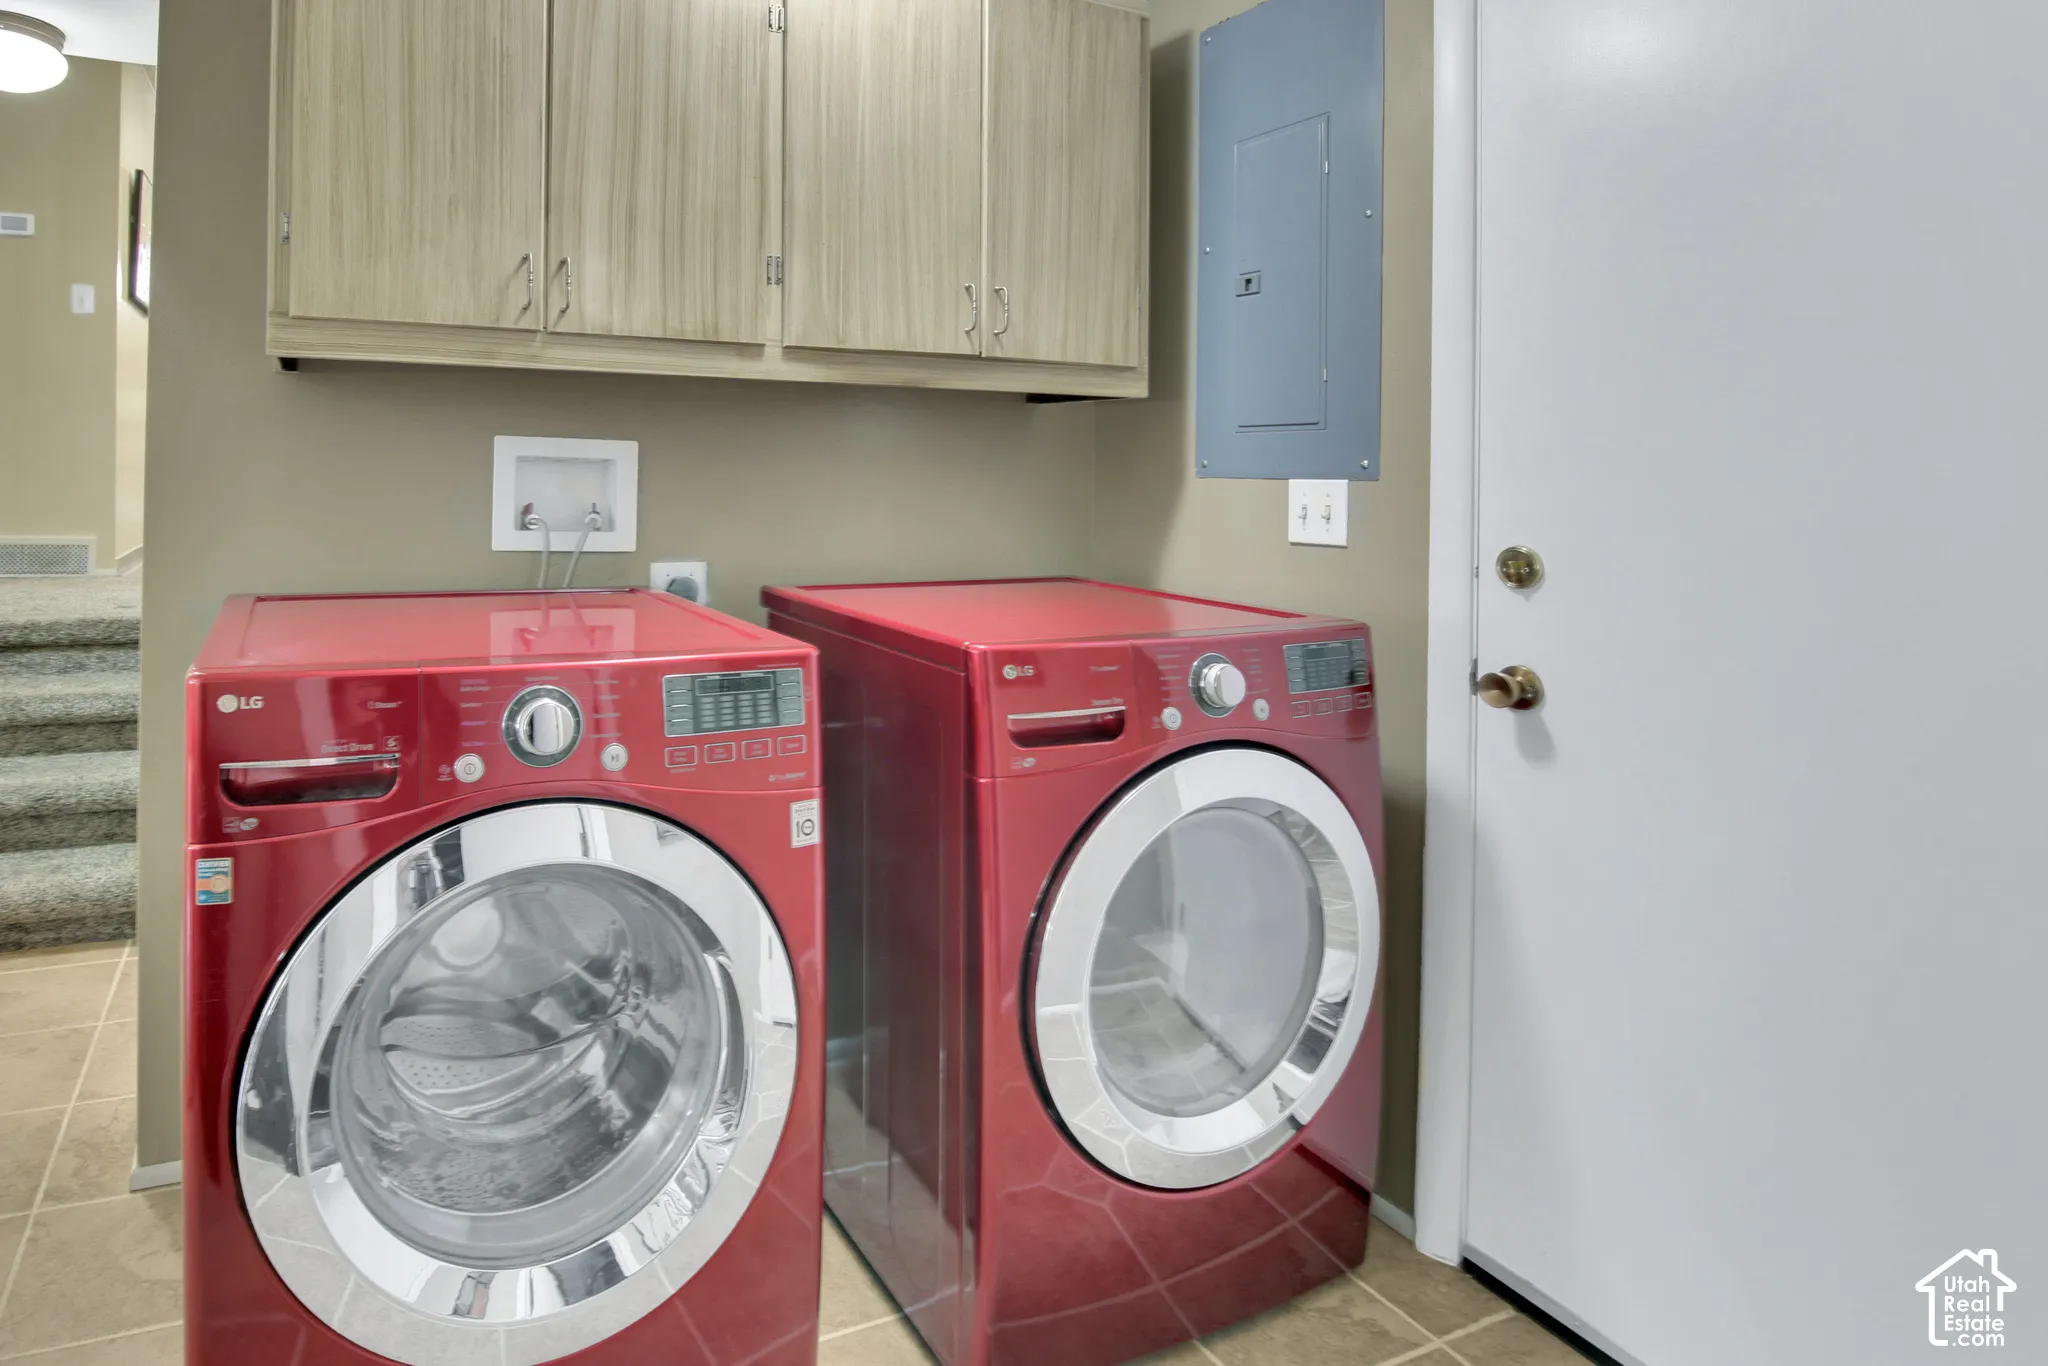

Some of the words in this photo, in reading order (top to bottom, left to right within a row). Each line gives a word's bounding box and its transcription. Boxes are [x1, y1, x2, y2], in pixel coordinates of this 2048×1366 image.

[1018, 665, 1034, 676] LG
[240, 696, 264, 709] LG
[349, 743, 374, 751] Drive
[796, 819, 814, 837] 10
